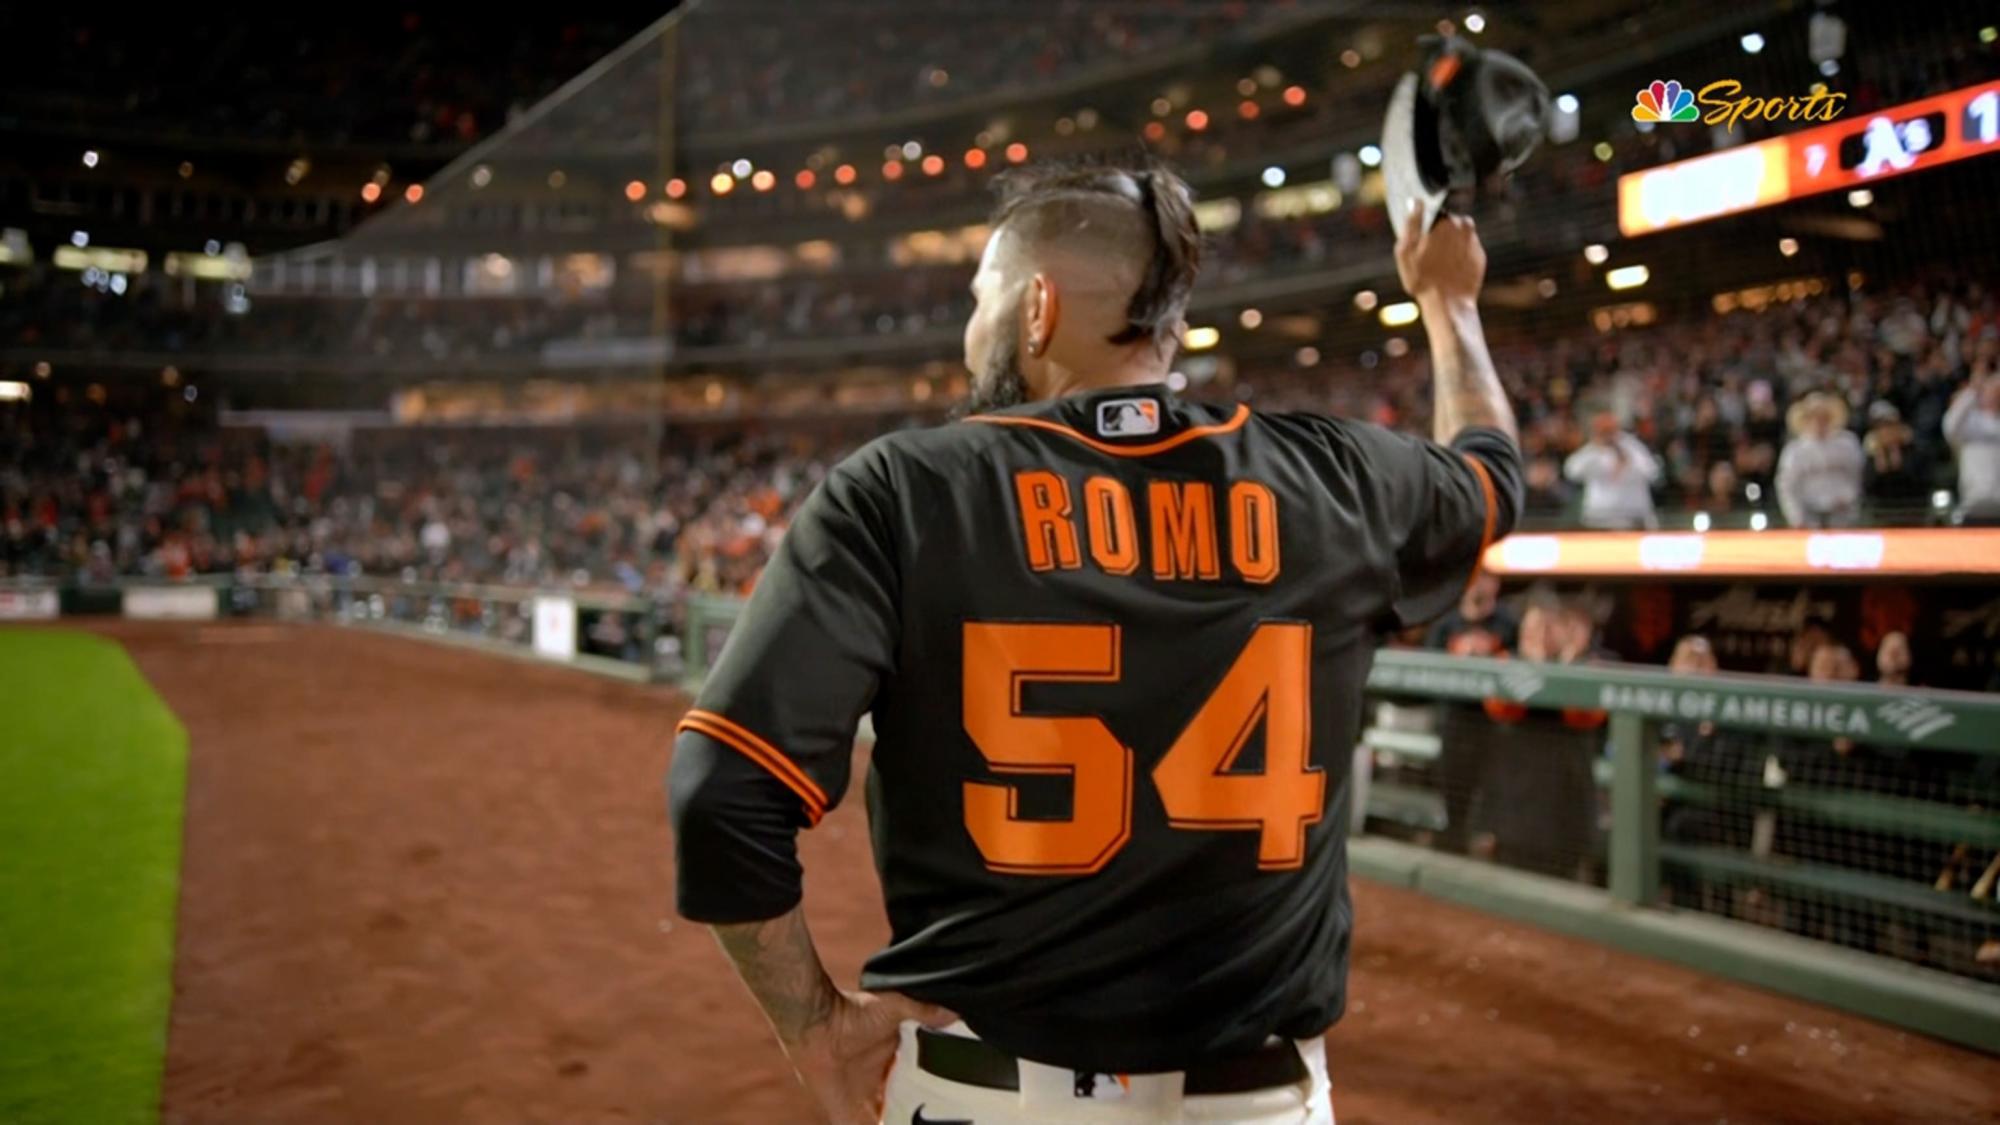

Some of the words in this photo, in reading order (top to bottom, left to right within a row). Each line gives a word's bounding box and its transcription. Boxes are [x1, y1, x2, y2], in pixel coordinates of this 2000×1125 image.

[1015, 470, 1281, 584] ROMO
[963, 618, 1327, 873] 54
[1600, 684, 1674, 714] BANK
[1678, 690, 1718, 718] OF
[1721, 697, 1871, 735] AMERICA
